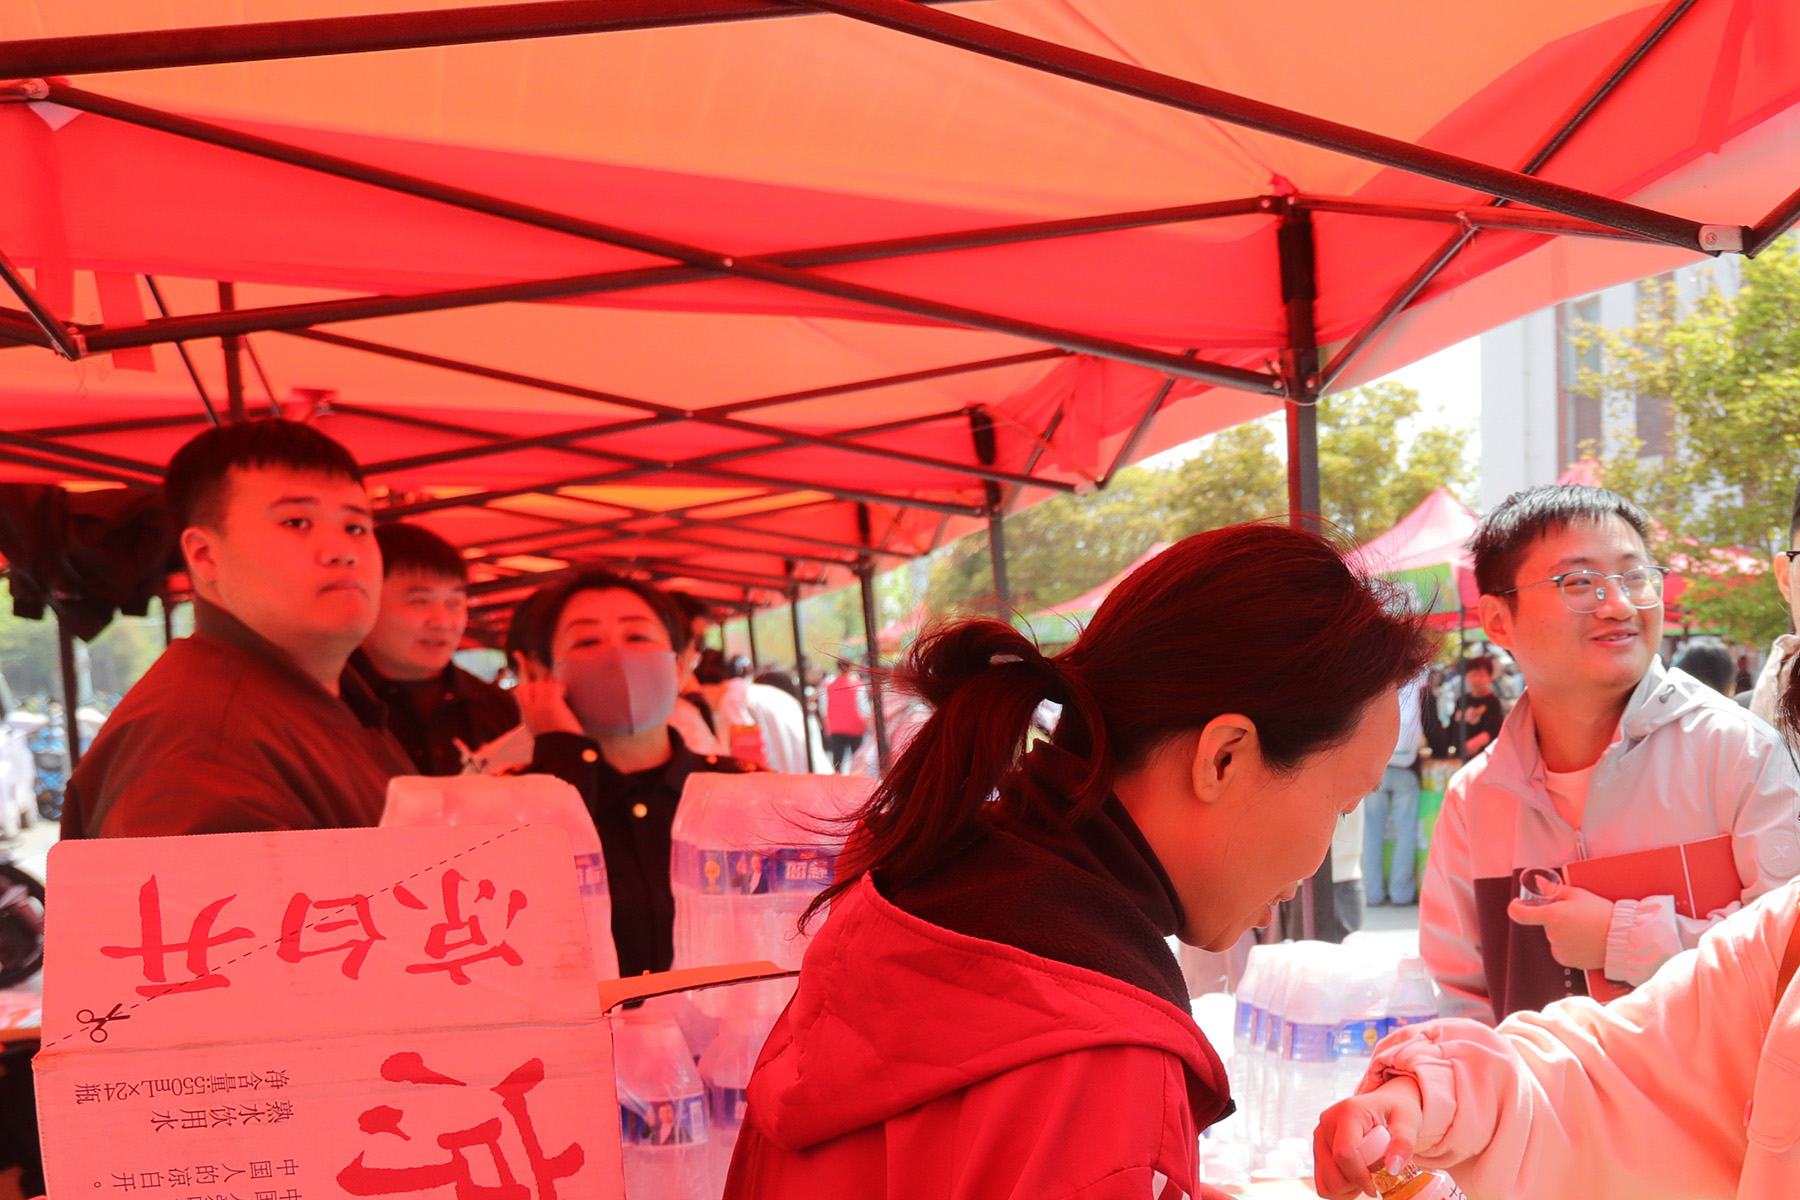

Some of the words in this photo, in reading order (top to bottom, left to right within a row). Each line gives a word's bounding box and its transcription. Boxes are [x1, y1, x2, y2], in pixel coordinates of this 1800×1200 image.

[100, 868, 528, 998] 凉白开
[150, 1099, 295, 1133] 熟水饮用水
[93, 1158, 300, 1193] 中国人的凉白开。
